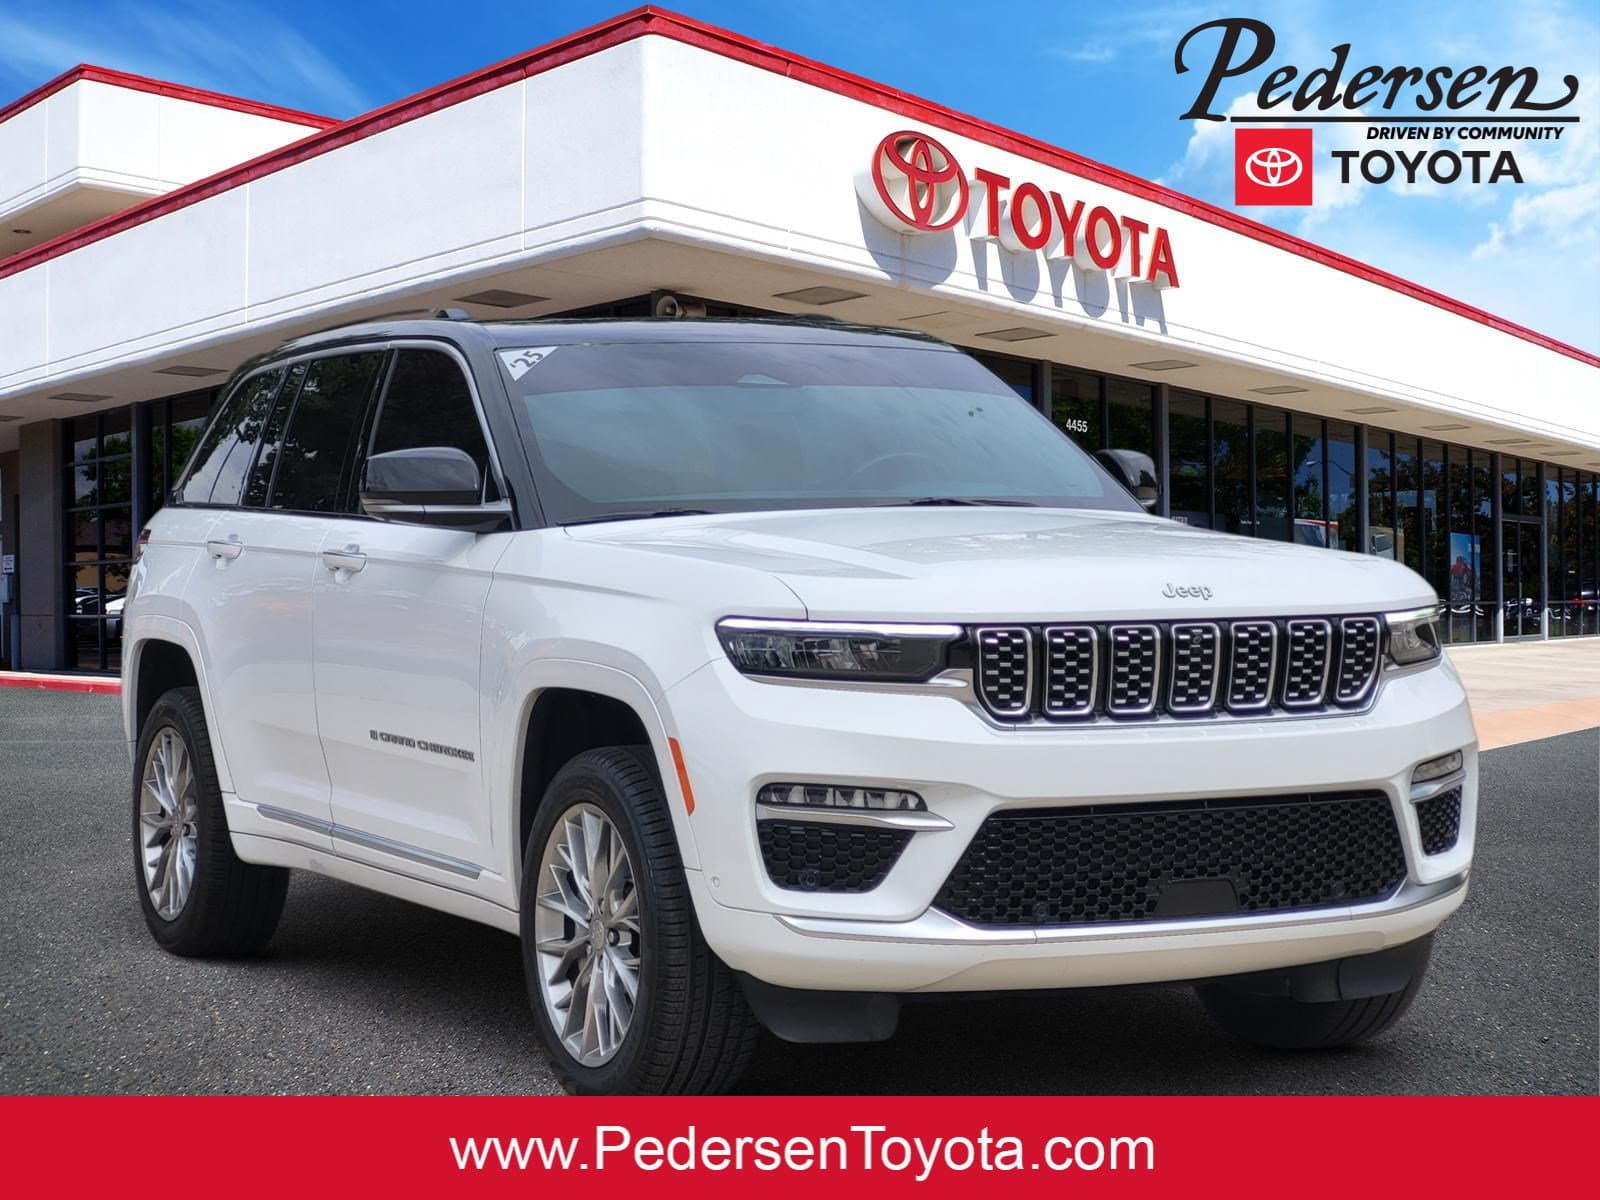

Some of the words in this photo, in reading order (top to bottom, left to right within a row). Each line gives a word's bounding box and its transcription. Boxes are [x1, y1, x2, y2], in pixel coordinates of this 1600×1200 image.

[974, 167, 1180, 289] TOYOTA
[1065, 418, 1088, 433] 4455
[1161, 582, 1214, 601] Jeep
